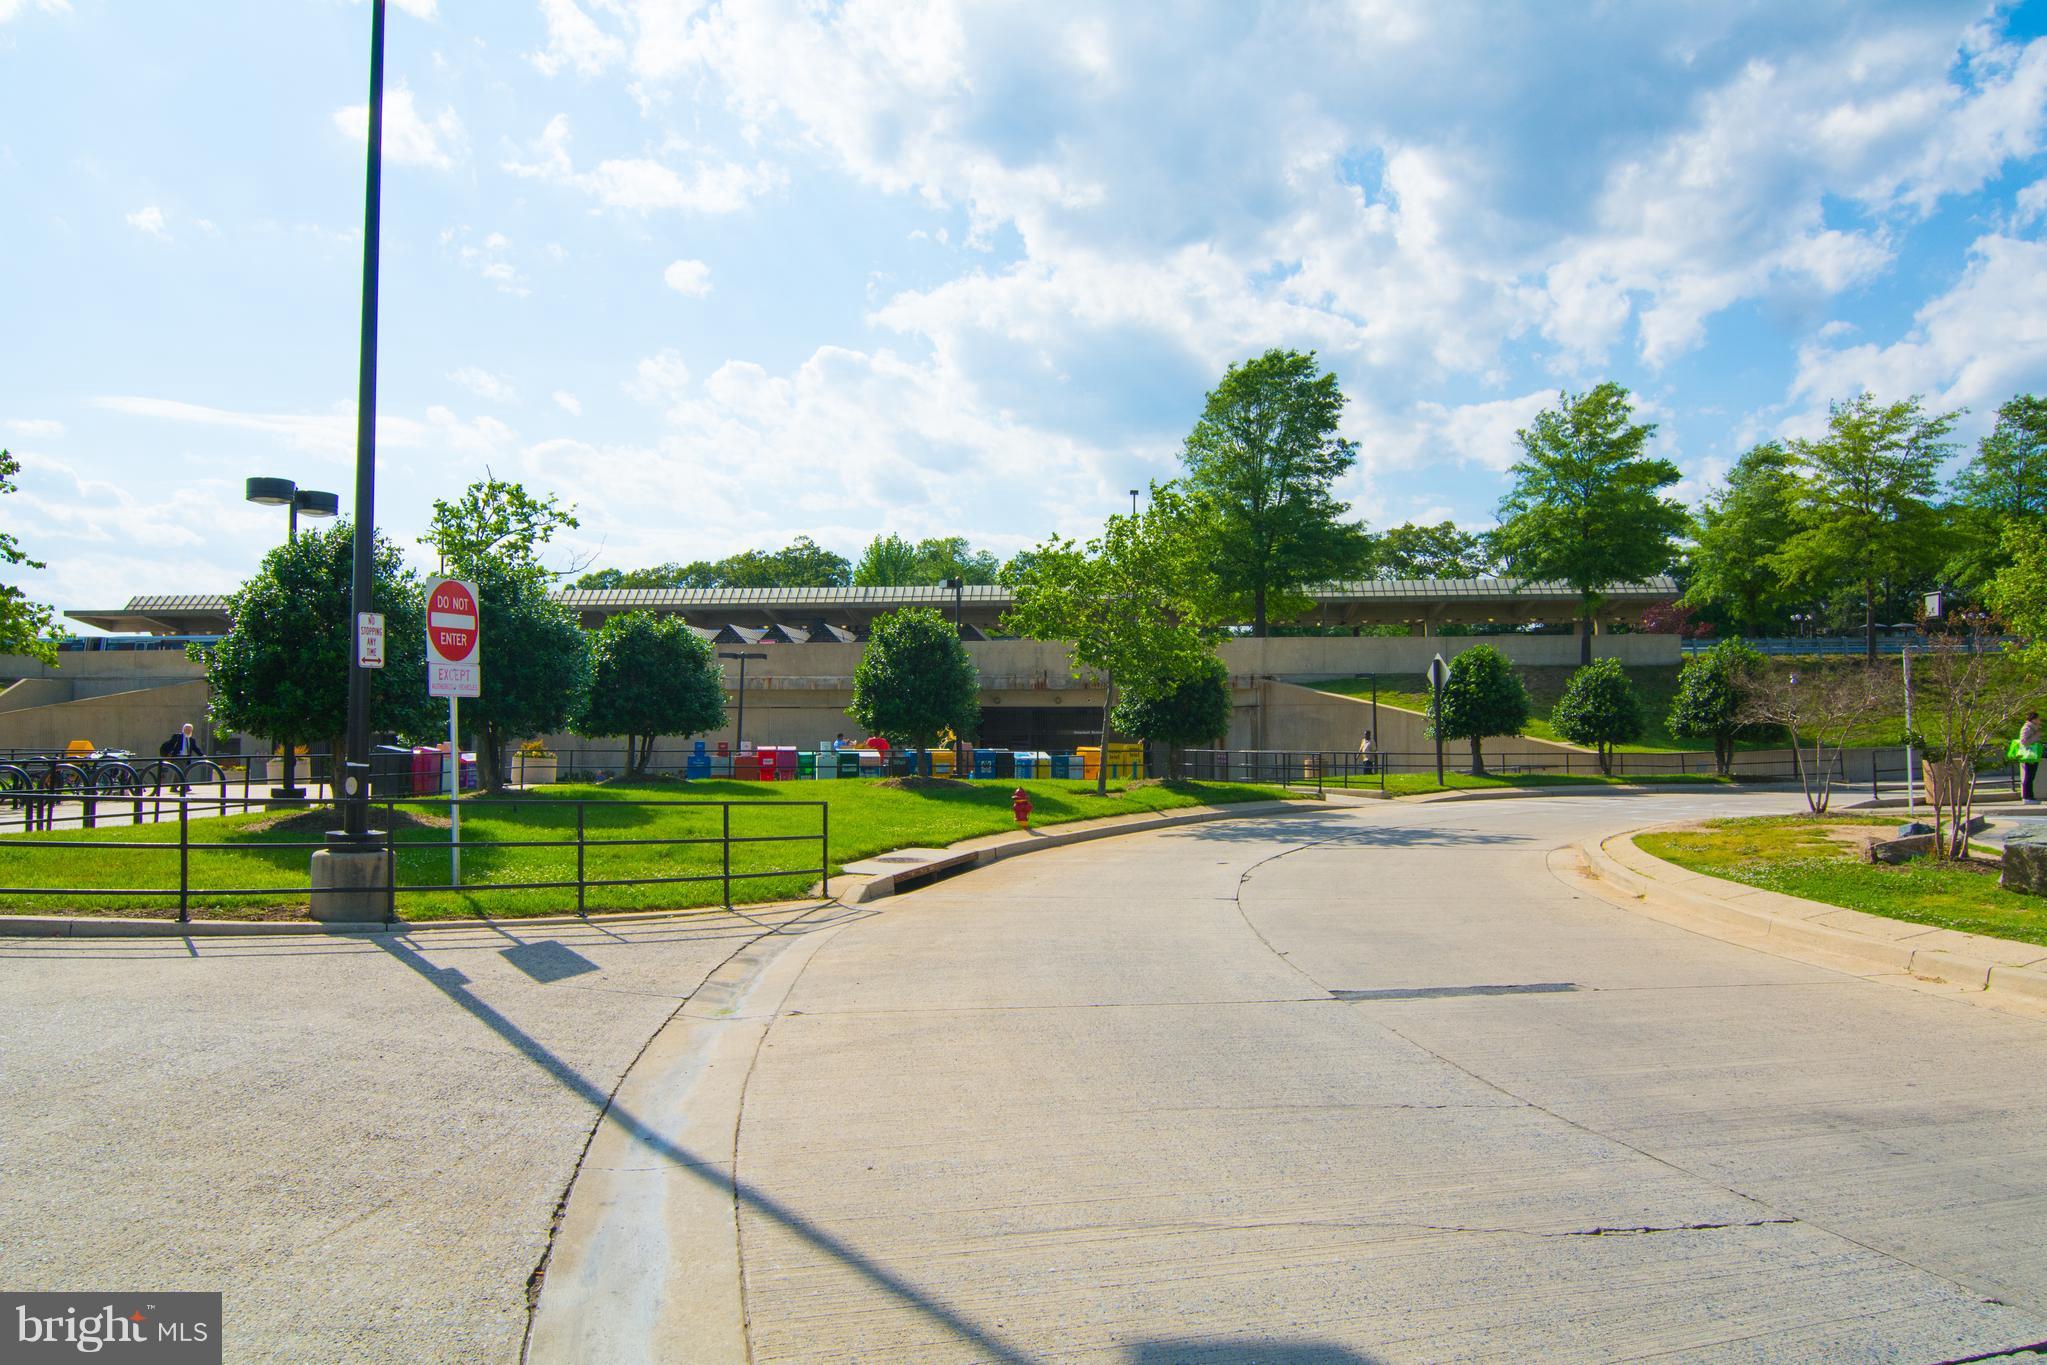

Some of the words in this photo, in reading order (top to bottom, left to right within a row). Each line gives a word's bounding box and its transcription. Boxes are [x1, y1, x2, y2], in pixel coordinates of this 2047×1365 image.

[437, 595, 449, 609] DO
[452, 597, 469, 611] NOT
[368, 616, 376, 625] NO
[361, 626, 383, 636] STOPPING
[367, 637, 377, 647] ANY
[440, 632, 467, 646] ENTER
[367, 647, 377, 656] TIME
[438, 668, 471, 682] EXCEPT
